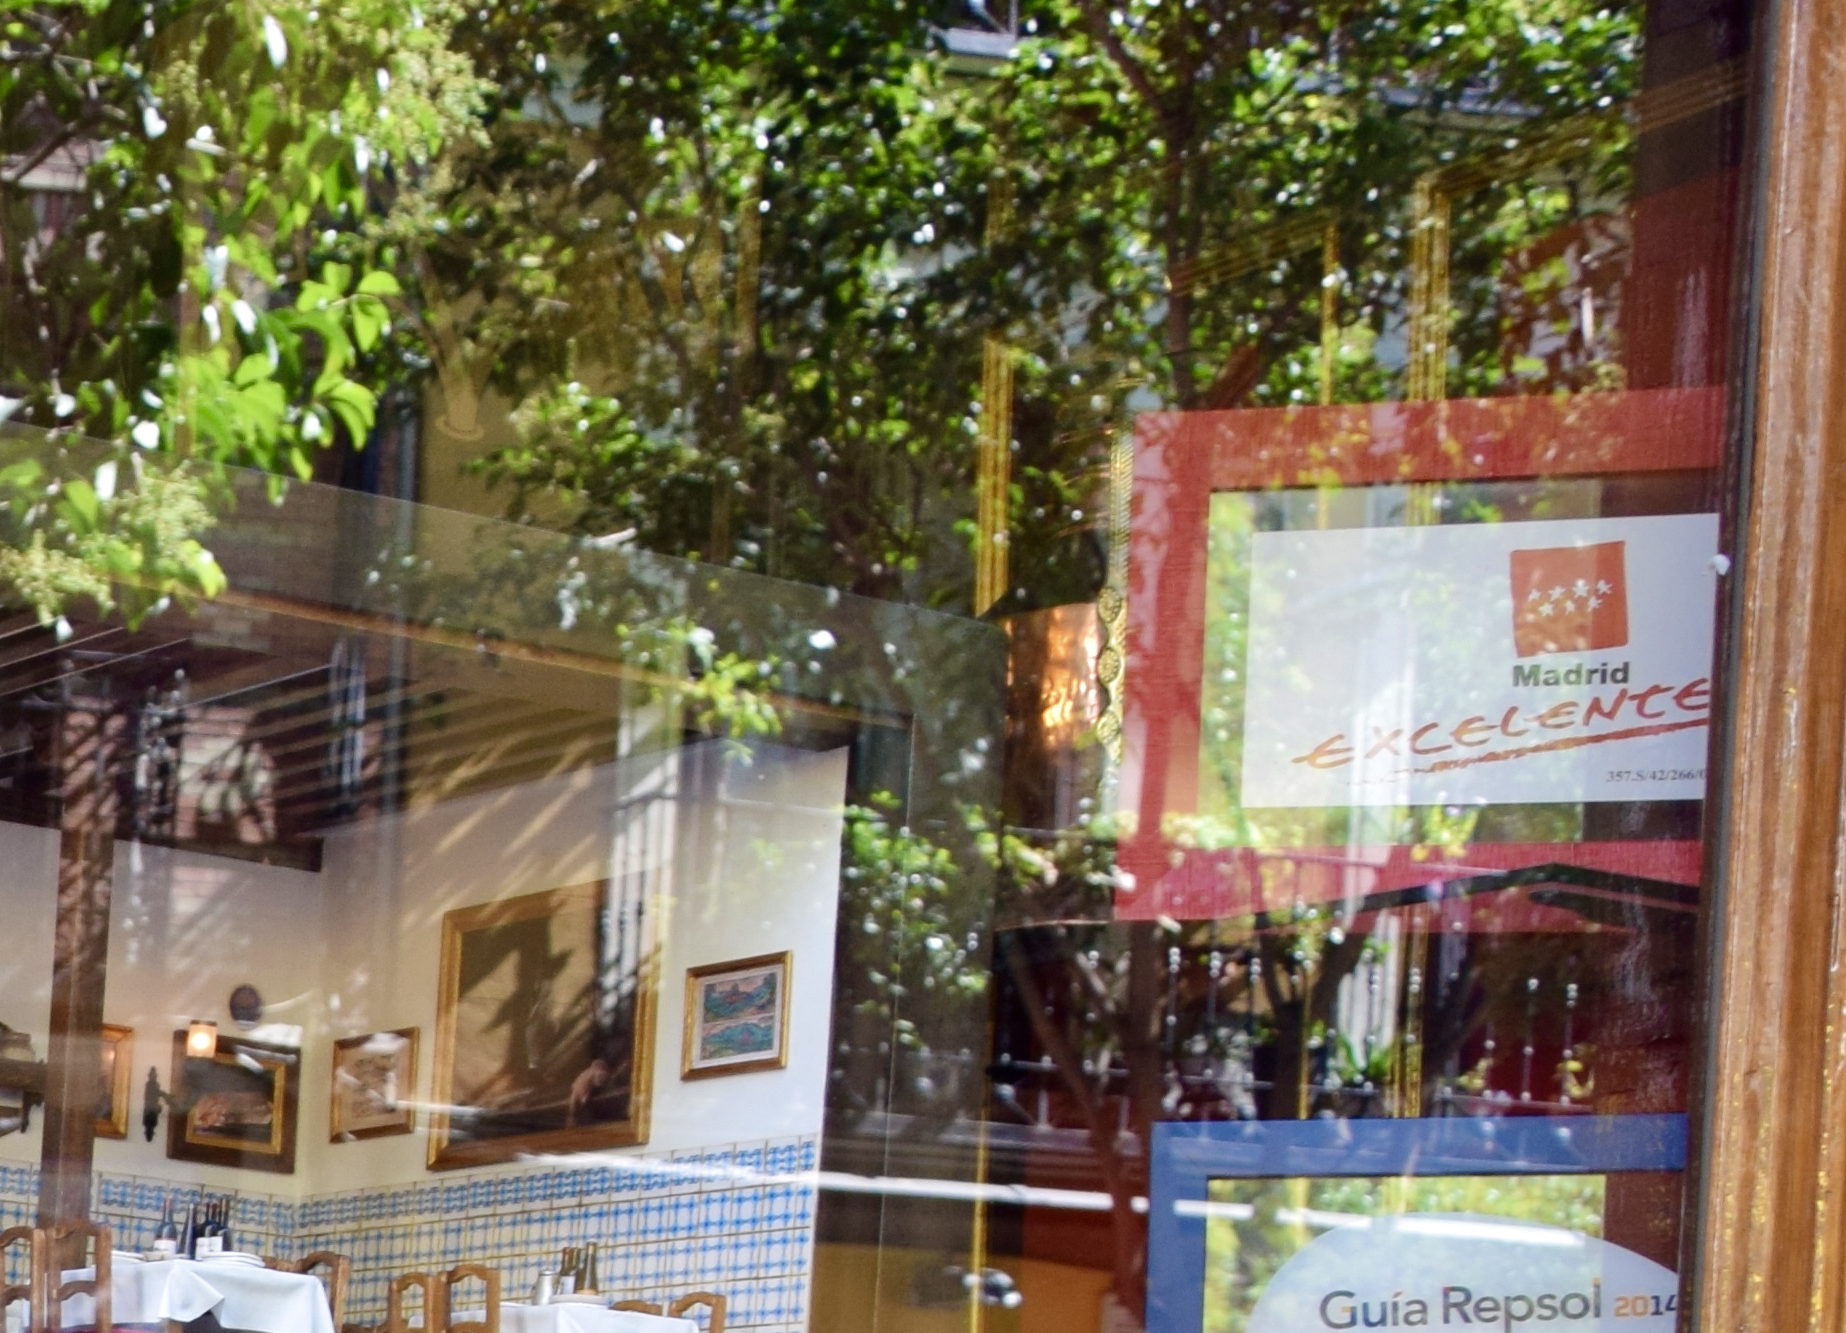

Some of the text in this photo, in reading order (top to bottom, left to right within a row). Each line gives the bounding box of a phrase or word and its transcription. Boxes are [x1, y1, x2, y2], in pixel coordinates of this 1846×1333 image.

[1512, 661, 1631, 688] Madrid
[1293, 676, 1712, 770] EXCELENTE
[1319, 1288, 1429, 1331] Guía
[1442, 1276, 1603, 1333] Repsol
